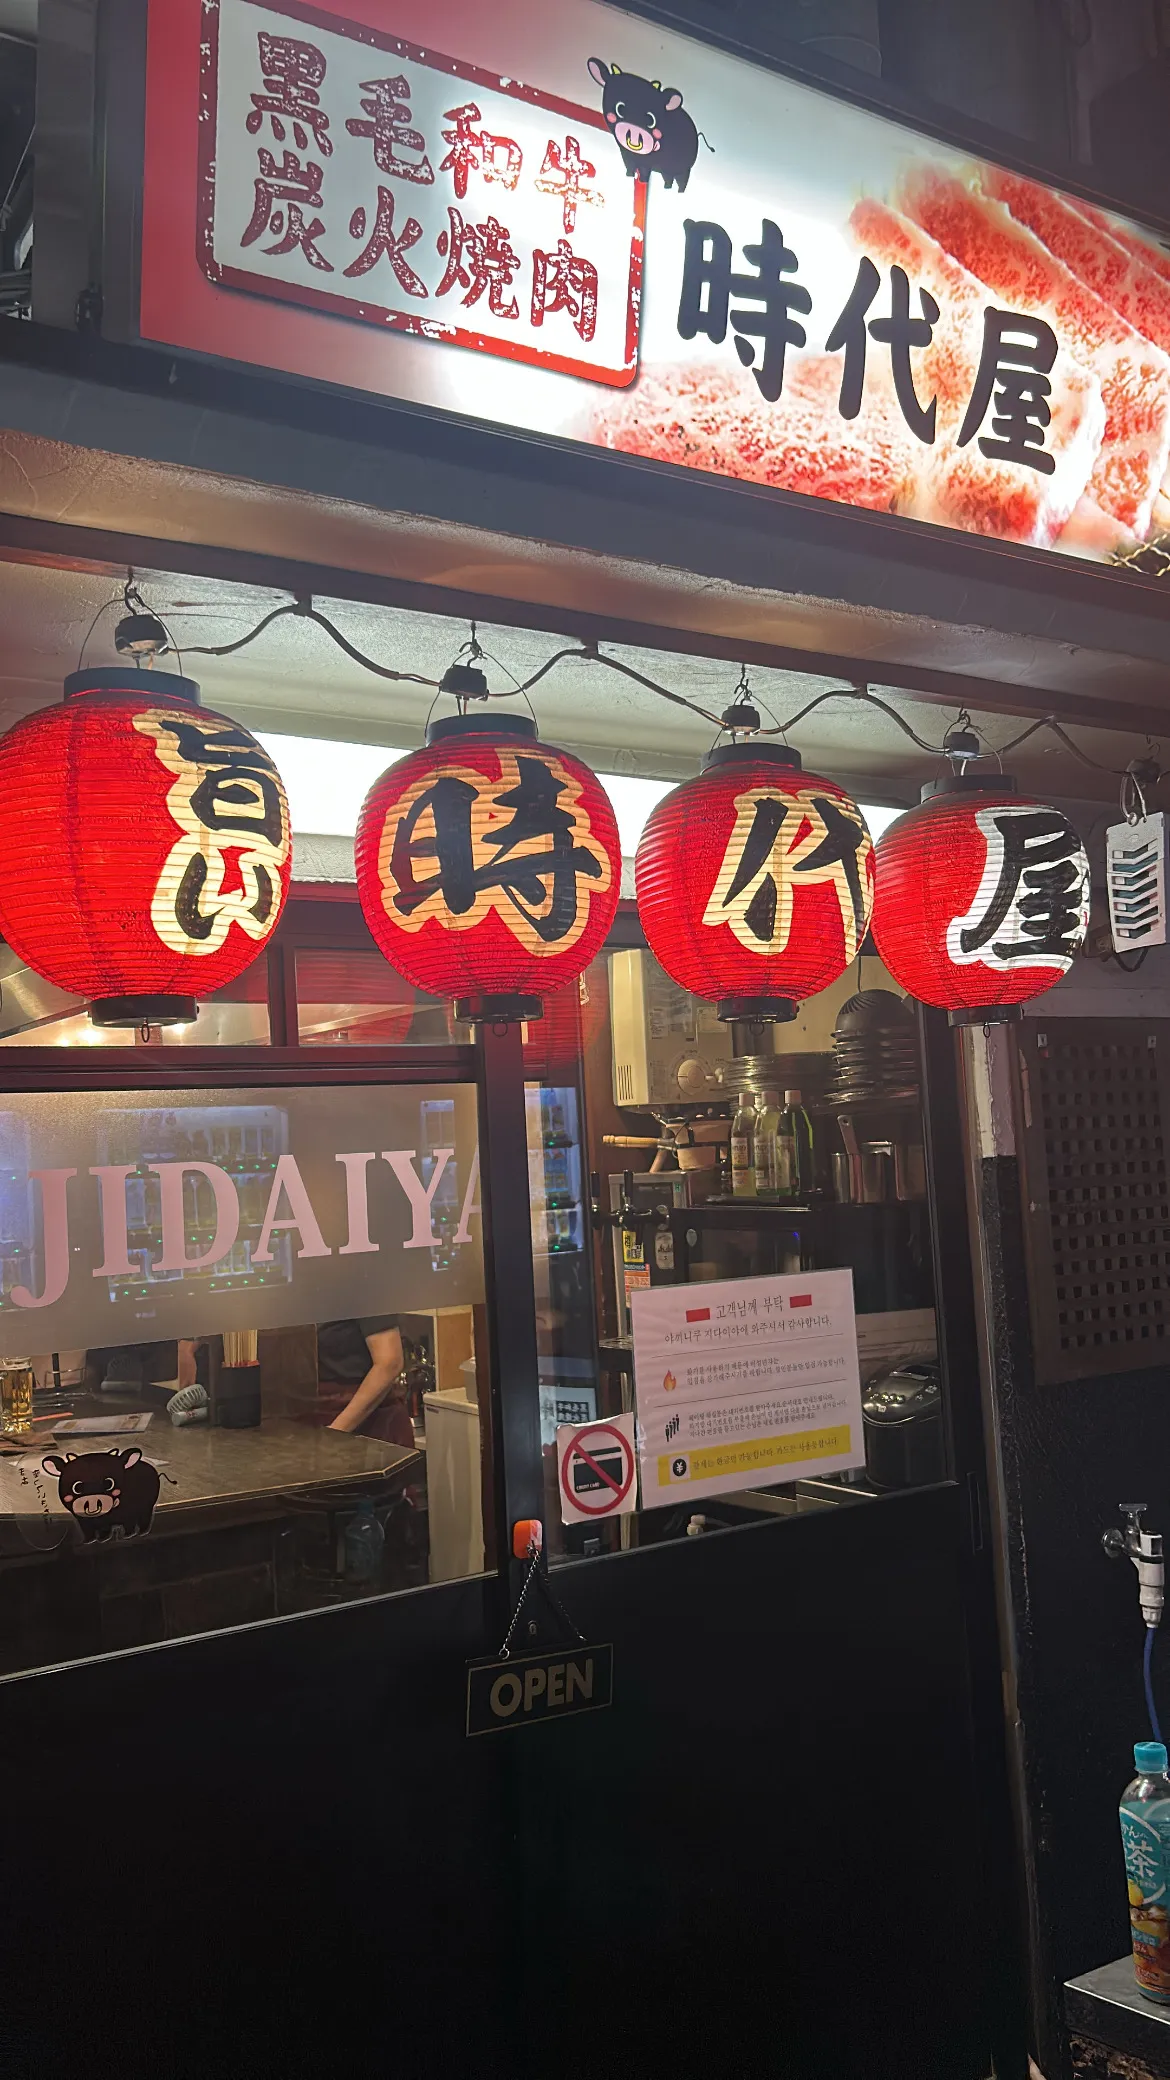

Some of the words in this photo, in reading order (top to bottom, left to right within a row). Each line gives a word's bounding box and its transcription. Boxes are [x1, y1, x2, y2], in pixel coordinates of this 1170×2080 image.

[246, 32, 604, 233] 黒毛和牛
[240, 149, 598, 342] 炭火焼肉
[677, 218, 1058, 476] 時代屋
[390, 756, 602, 942] 時
[961, 812, 1083, 961] 屋
[715, 1297, 757, 1320] 고객님께
[762, 1294, 784, 1314] 부탁
[490, 1658, 593, 1717] OPEN
